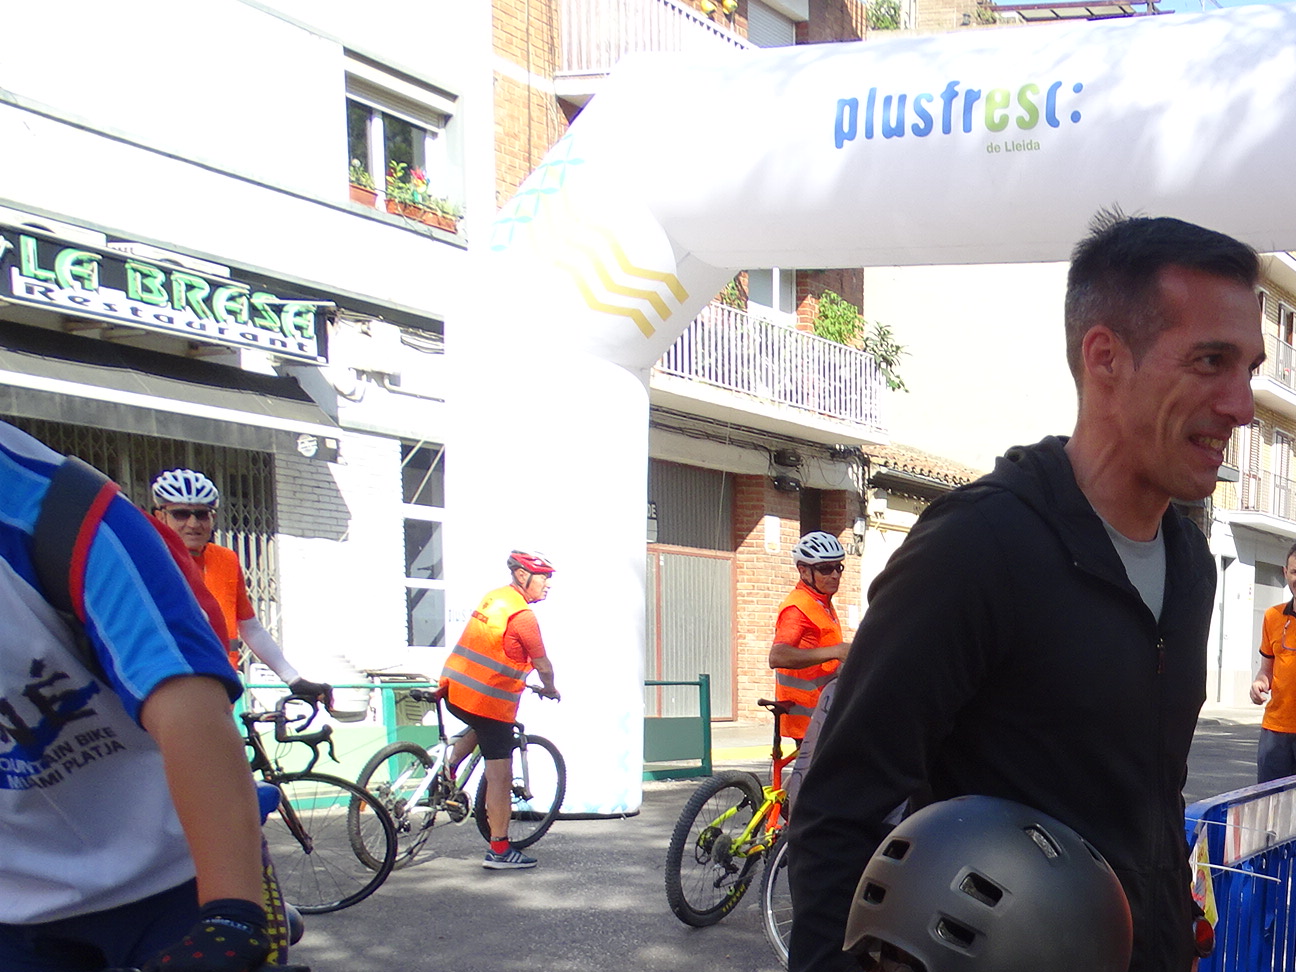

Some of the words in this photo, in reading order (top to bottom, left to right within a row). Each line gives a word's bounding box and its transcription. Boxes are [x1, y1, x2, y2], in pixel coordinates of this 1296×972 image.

[986, 141, 1001, 153] de
[1004, 139, 1040, 153] Lleida
[20, 234, 102, 292] LA
[125, 259, 318, 340] BRASA
[24, 281, 309, 353] Restaurant
[75, 727, 118, 746] BIKE
[7, 769, 64, 789] MIAMI
[62, 740, 127, 774] PLATJA
